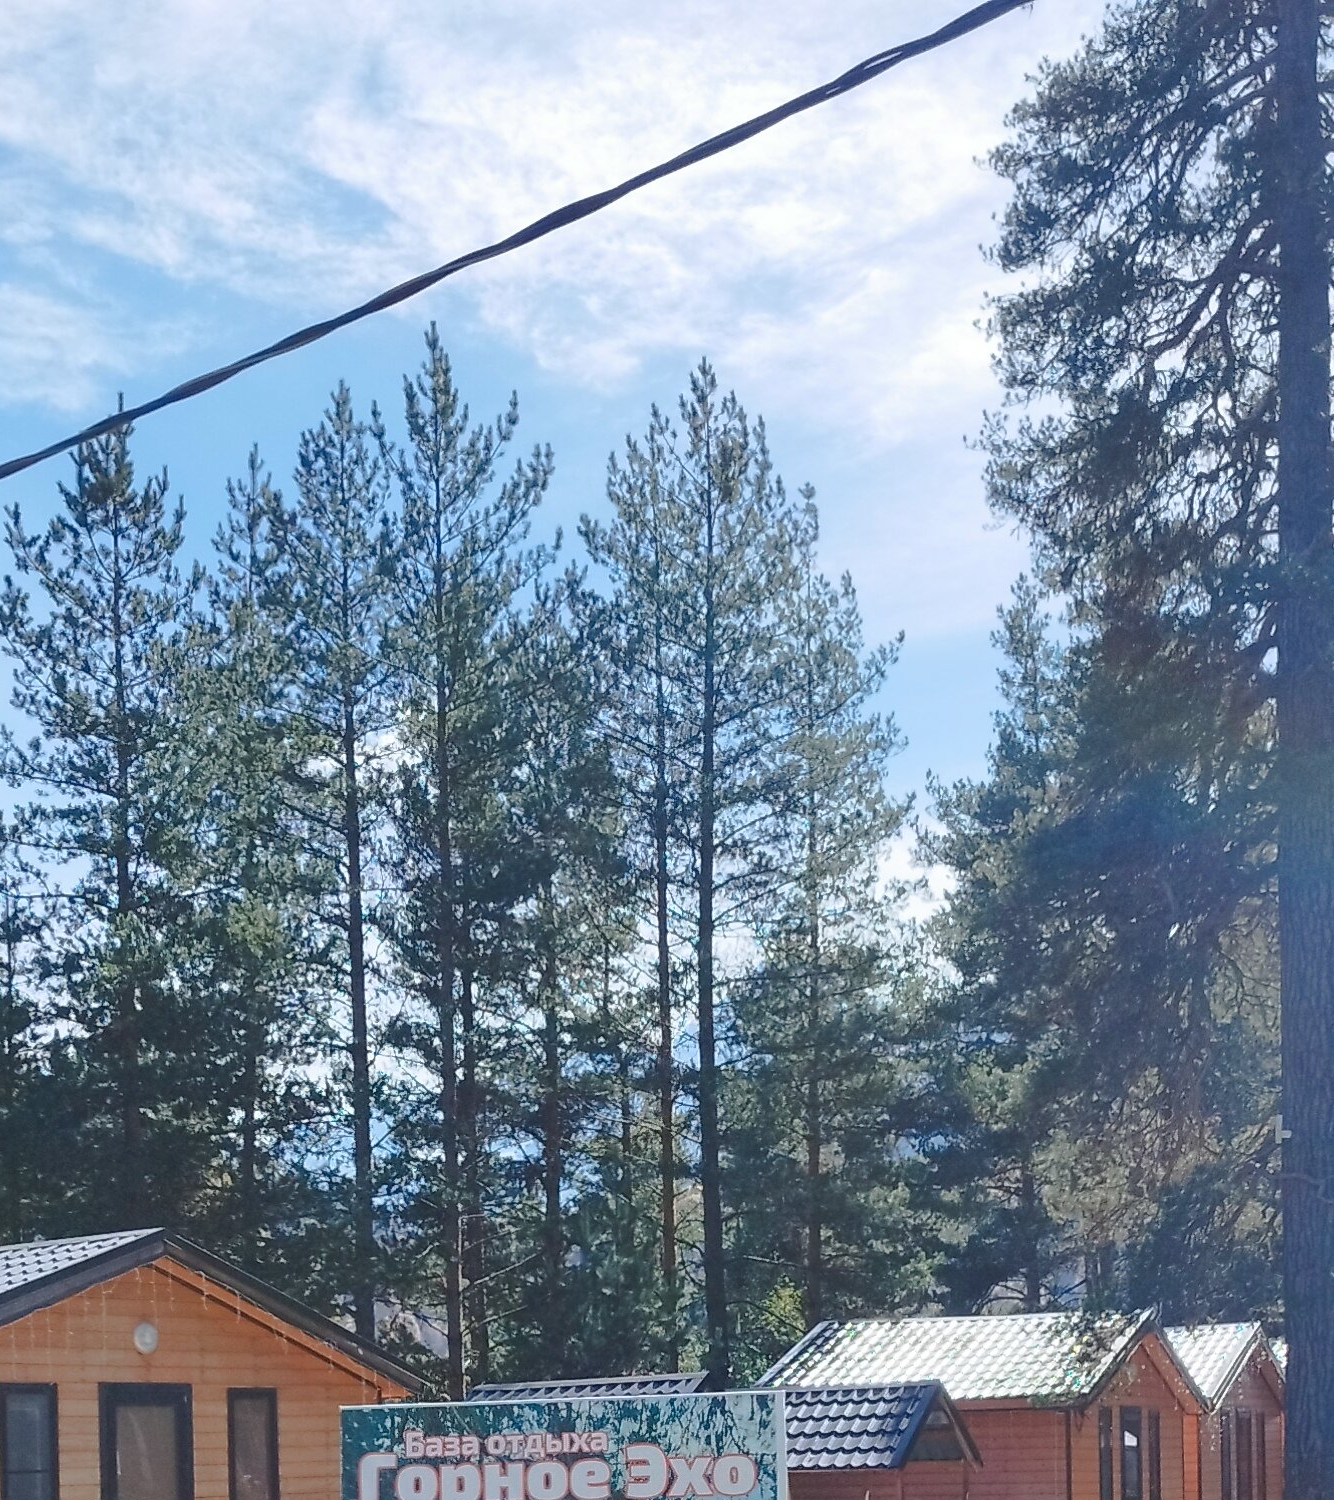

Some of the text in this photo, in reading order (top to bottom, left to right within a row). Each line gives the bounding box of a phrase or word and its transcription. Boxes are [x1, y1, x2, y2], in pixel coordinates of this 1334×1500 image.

[404, 1429, 609, 1458] База отдыха
[624, 1442, 758, 1499] Эхо
